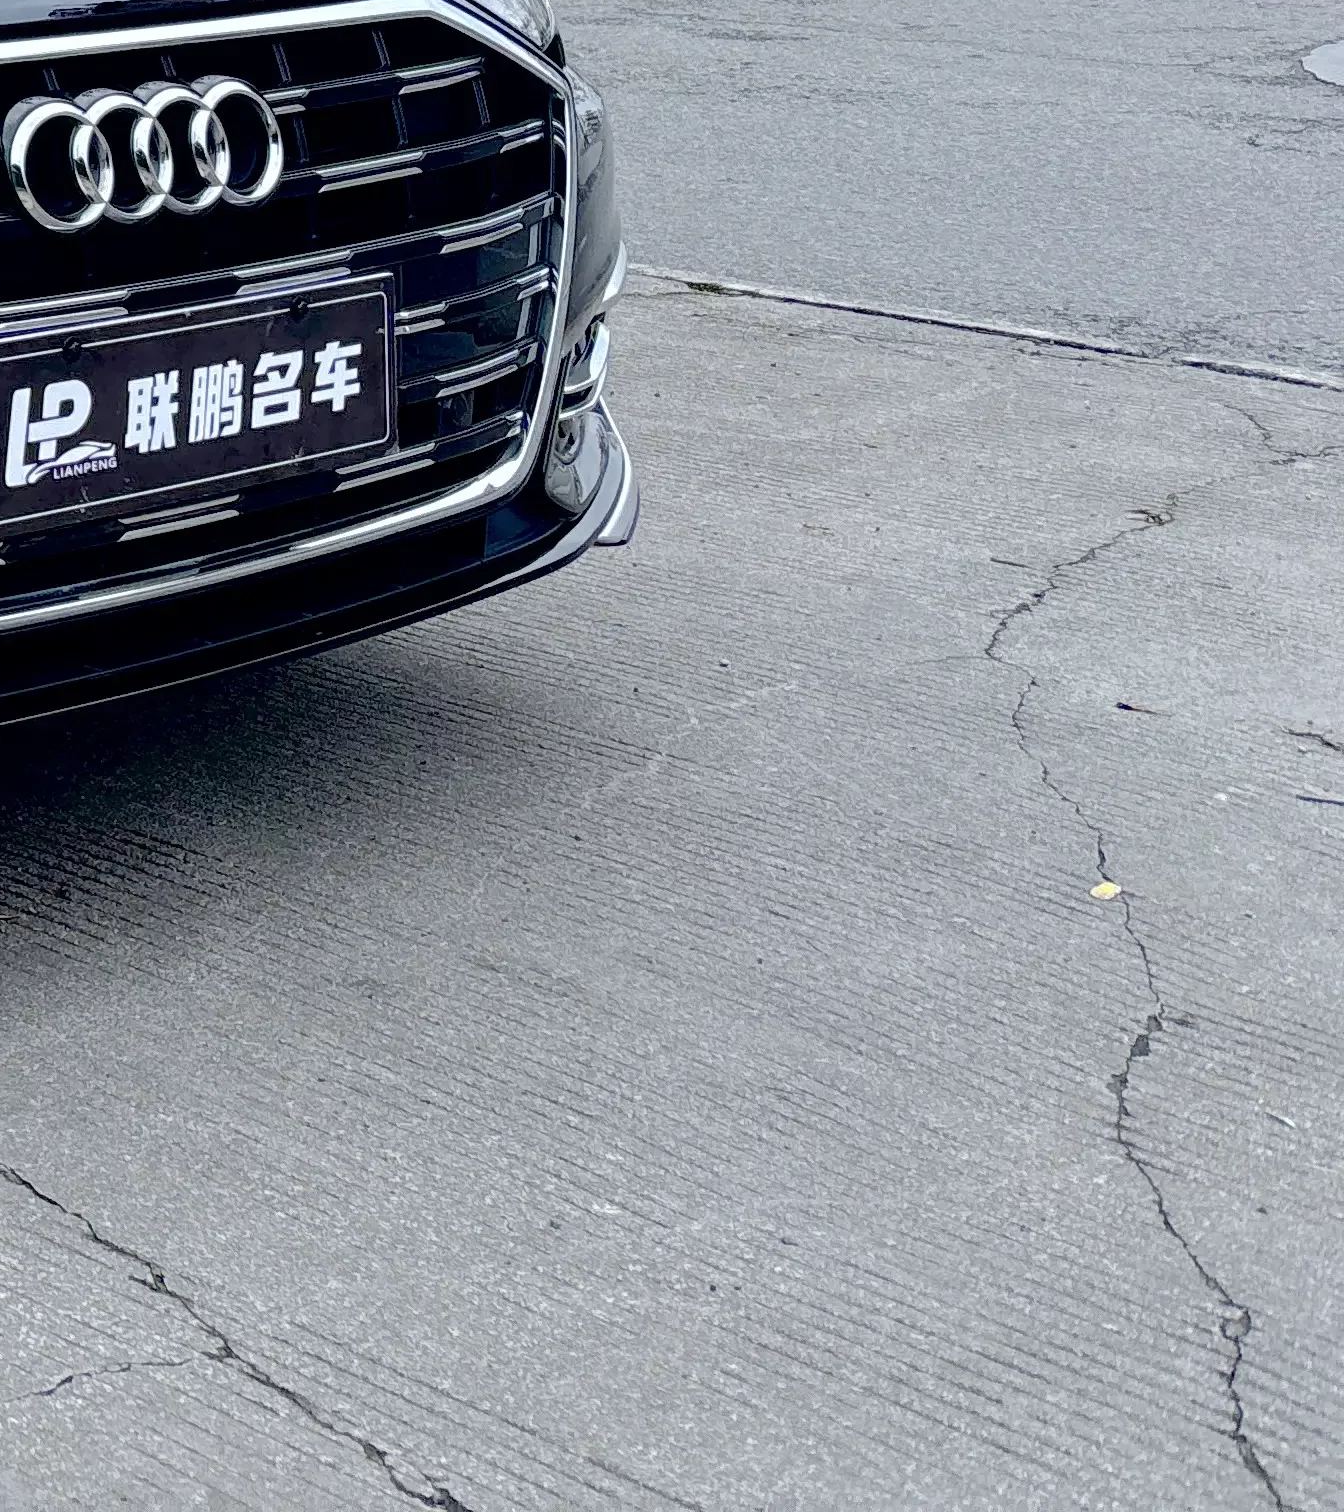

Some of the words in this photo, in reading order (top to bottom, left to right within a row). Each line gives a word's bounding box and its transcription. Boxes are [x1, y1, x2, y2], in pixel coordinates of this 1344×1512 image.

[124, 340, 363, 455] 联鹏名车
[53, 456, 118, 480] LIANPENG
